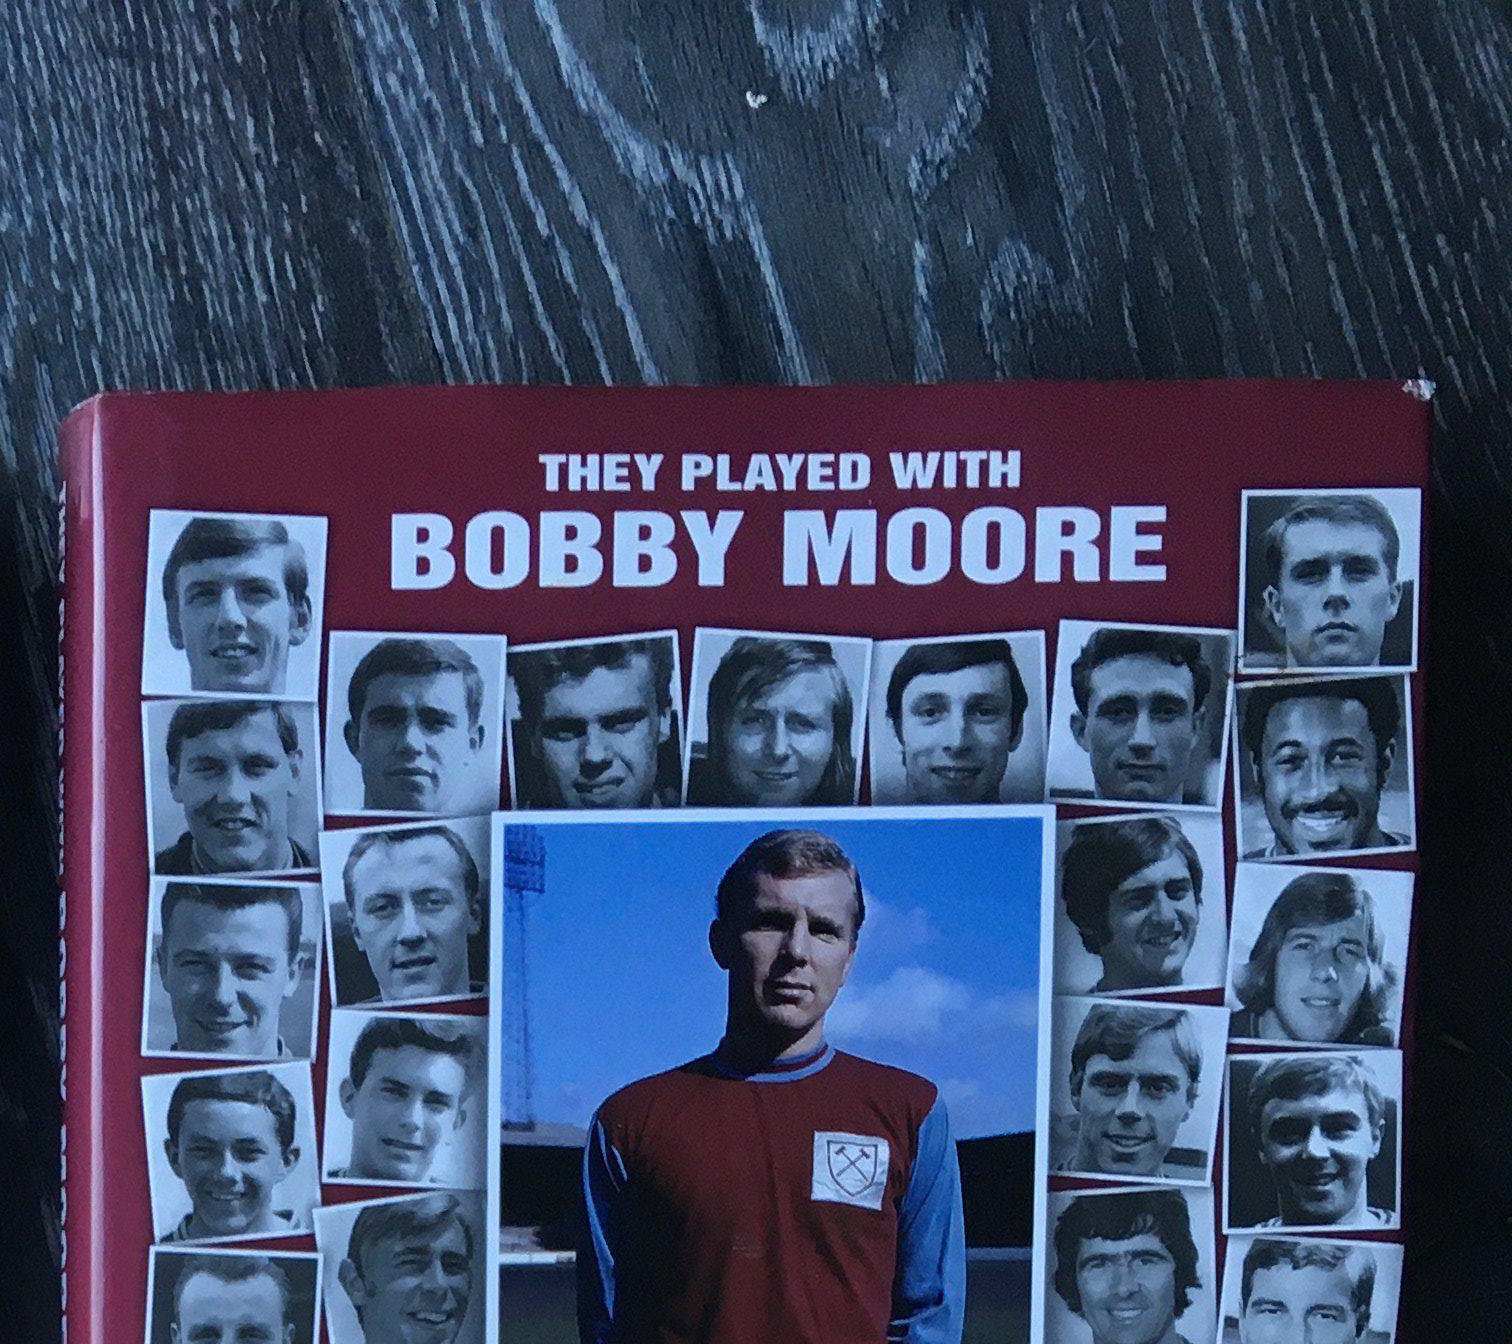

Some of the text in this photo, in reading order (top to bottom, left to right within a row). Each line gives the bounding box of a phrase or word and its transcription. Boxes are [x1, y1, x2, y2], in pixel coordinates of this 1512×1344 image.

[538, 449, 1021, 492] THEY PLAYED WITH
[390, 505, 1167, 591] BOBBY MOORE
